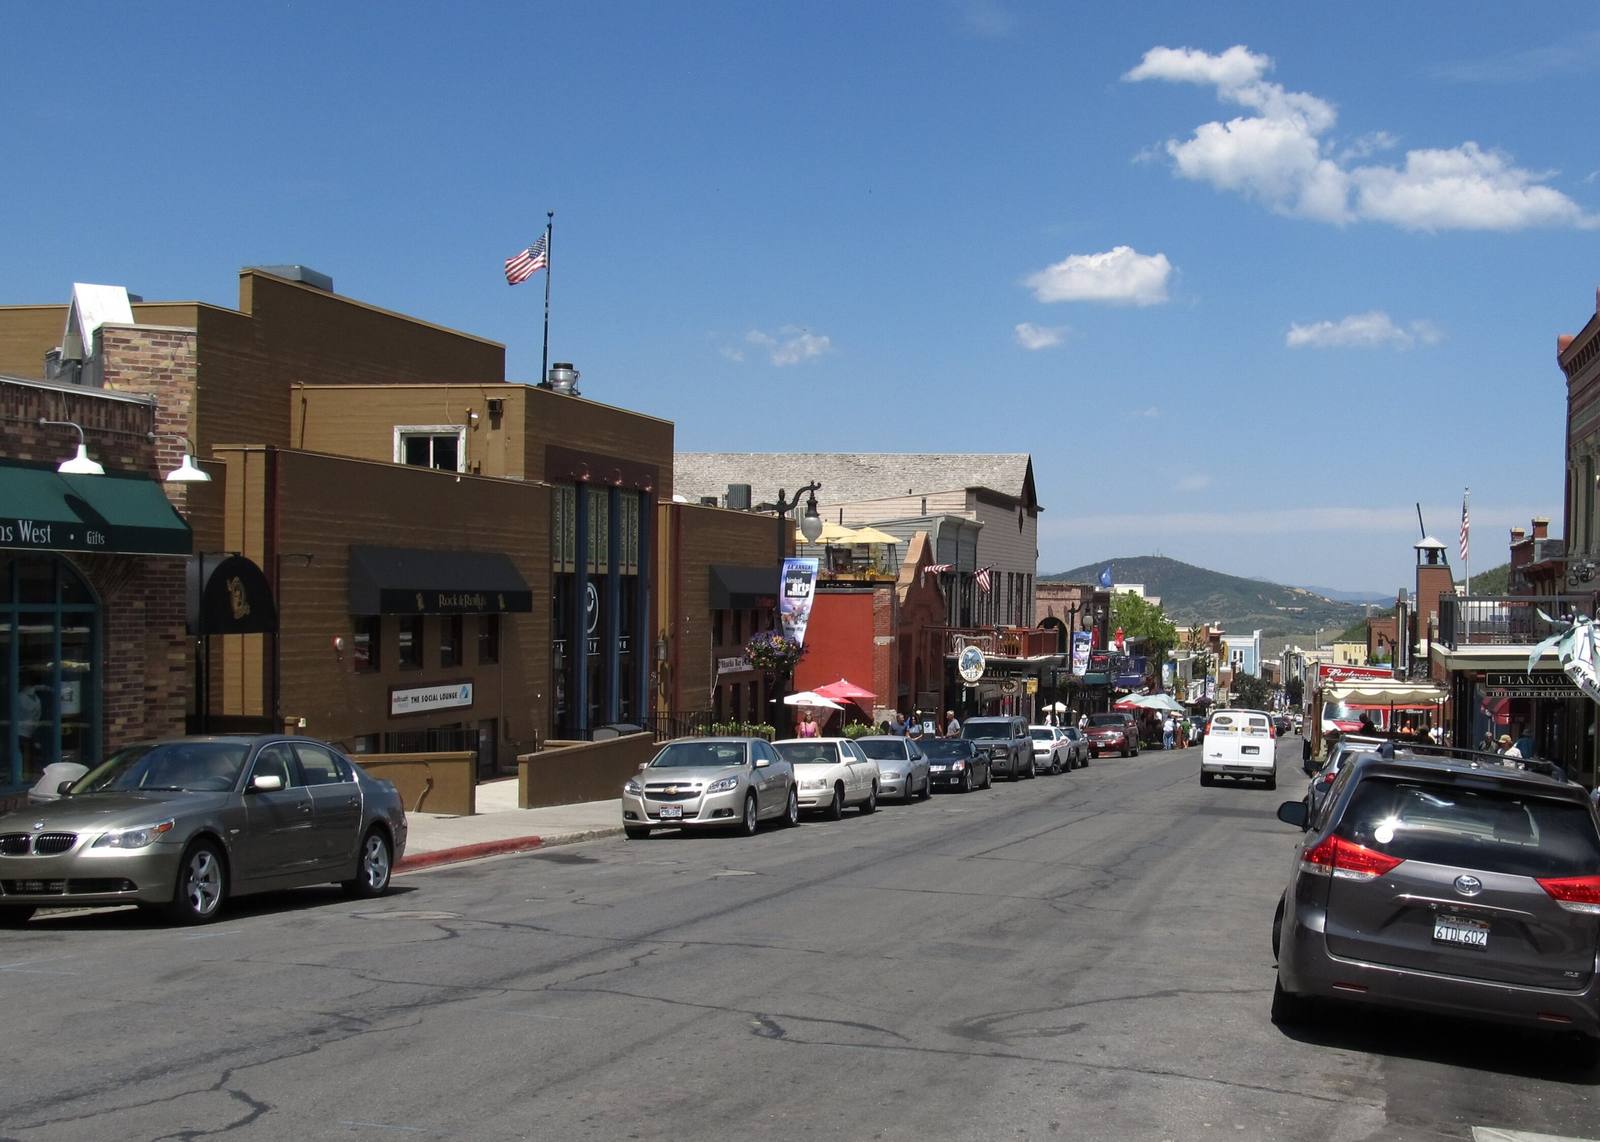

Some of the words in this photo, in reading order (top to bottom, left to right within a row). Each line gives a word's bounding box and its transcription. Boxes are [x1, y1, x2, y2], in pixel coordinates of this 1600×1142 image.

[18, 519, 52, 544] West
[86, 530, 105, 545] Gifts
[792, 582, 810, 592] arts
[411, 696, 420, 704] THE
[421, 693, 438, 703] SOCIAL
[439, 691, 458, 701] LOUNGE
